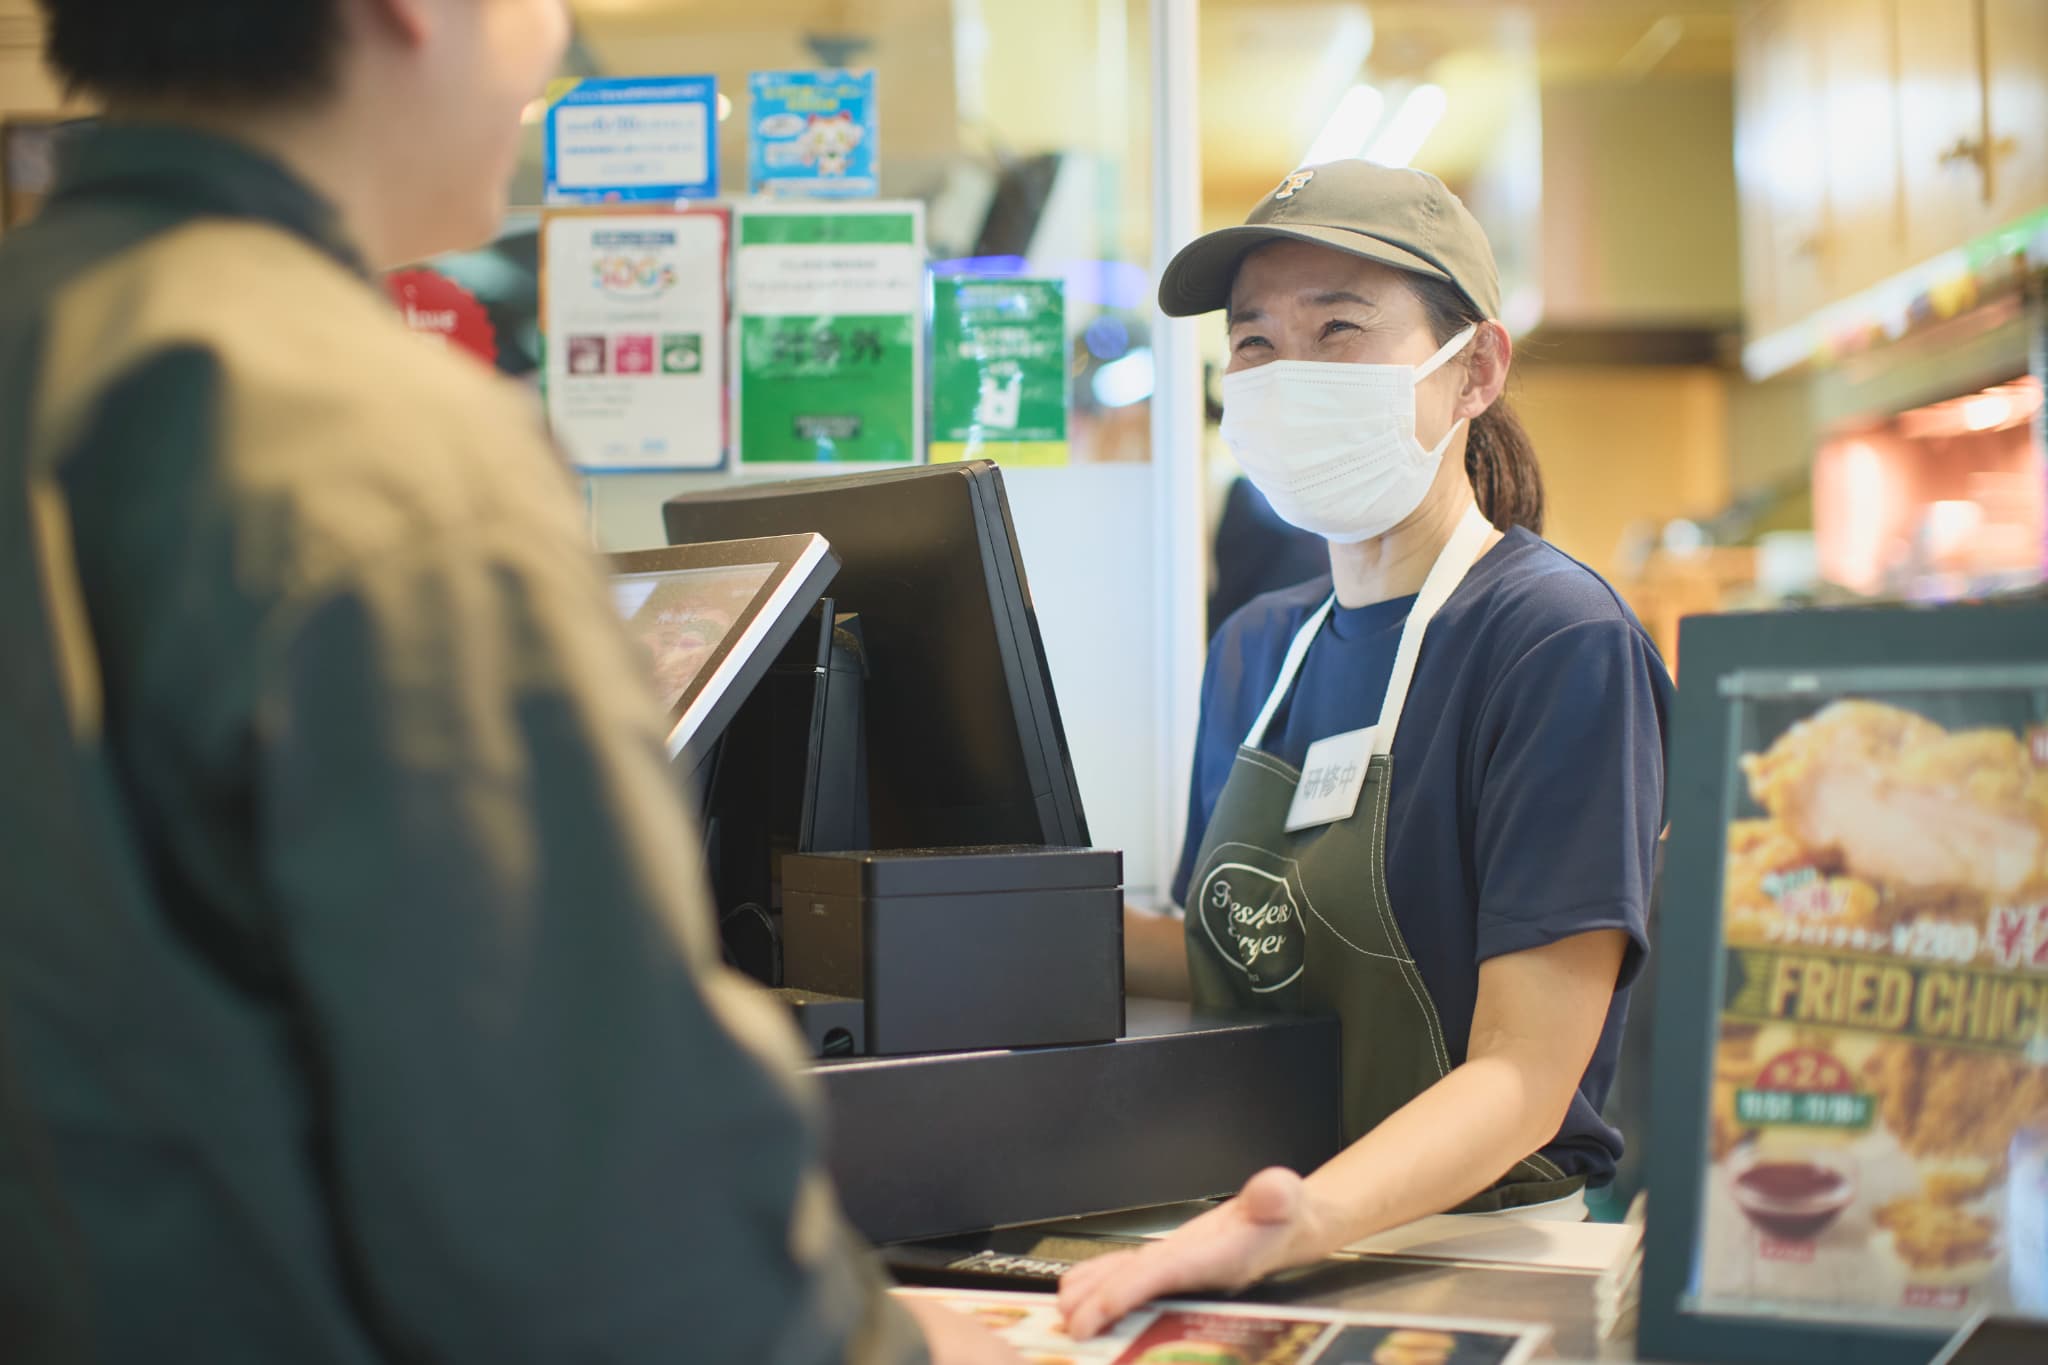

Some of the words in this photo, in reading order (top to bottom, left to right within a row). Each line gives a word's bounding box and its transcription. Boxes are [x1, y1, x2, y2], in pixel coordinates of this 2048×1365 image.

[1303, 761, 1358, 799] 研修中
[1769, 955, 1914, 1031] FRIED
